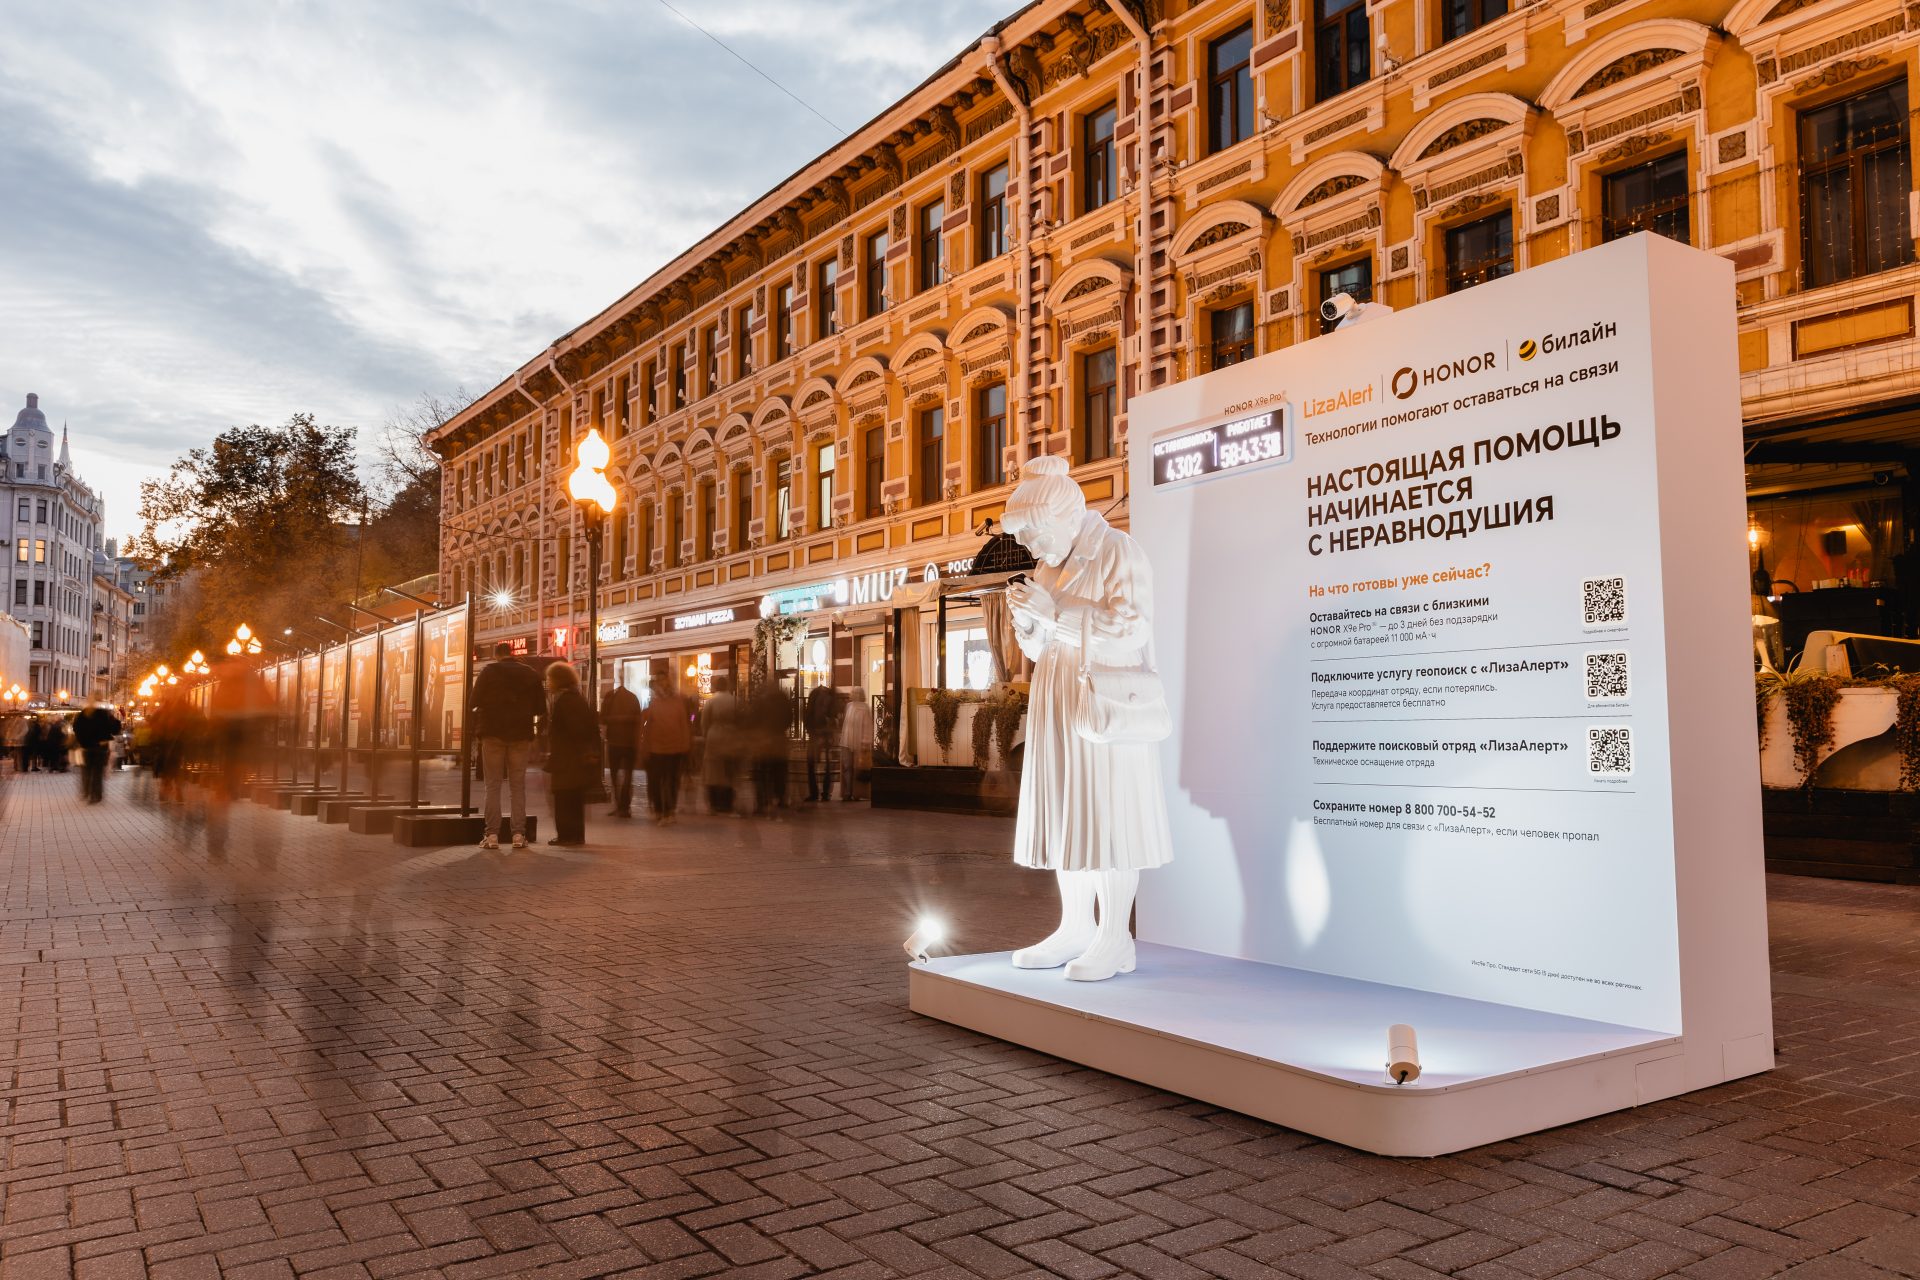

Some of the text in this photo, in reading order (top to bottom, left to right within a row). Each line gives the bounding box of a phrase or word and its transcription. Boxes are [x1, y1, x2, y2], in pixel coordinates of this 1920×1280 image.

[1541, 321, 1617, 355] билайн
[1423, 352, 1496, 386] HONOR
[1224, 400, 1253, 415] HONOR
[1254, 396, 1269, 406] X9e
[1303, 384, 1374, 418] LizaAlert
[1305, 360, 1619, 446] Технологии помогают оставаться на связи
[1166, 452, 1203, 480] 4302
[1307, 414, 1622, 499] НАСТОЯЩАЯ ПОМОЩЬ
[1307, 476, 1473, 528] НАЧИНАЕТСЯ
[1308, 495, 1554, 557] С НЕРАВНОДУШИЯ
[1309, 562, 1492, 598] На что готовы уже сейчас?
[1310, 596, 1490, 623] Оставайтесь на связи с близкими
[1310, 624, 1341, 636] HONOR
[1343, 623, 1358, 634] X9e
[1388, 622, 1399, 632] до
[1400, 619, 1406, 629] 3
[1407, 617, 1428, 630] дней
[1430, 617, 1444, 627] без
[1446, 613, 1498, 626] подзарядки
[1310, 641, 1316, 649] с
[1317, 637, 1352, 650] огромной
[1354, 633, 1390, 646] батареей
[1391, 633, 1398, 643] 11
[1311, 659, 1569, 684] Подключите услугу геопоиск с «ЛизаАлерт»
[1311, 689, 1347, 700] Передача
[1349, 687, 1389, 699] координат
[1391, 686, 1421, 698] отряду,
[1423, 685, 1443, 694] если
[1311, 698, 1446, 712] Услуга предоставляется бесплатно
[1312, 738, 1569, 756] Поддержите поисковый отряд «ЛизаАлерт»
[1312, 756, 1435, 769] Техническое оснащение отряда
[1312, 799, 1496, 819] Сохраните номер 8 800 700-54-52
[1313, 815, 1358, 828] Бесплатный
[1359, 820, 1385, 830] номер
[1386, 821, 1401, 831] для
[1403, 822, 1425, 832] связи
[1426, 823, 1432, 832] с
[1496, 827, 1518, 837] если
[1520, 829, 1560, 840] человек
[1562, 831, 1600, 843] пропал
